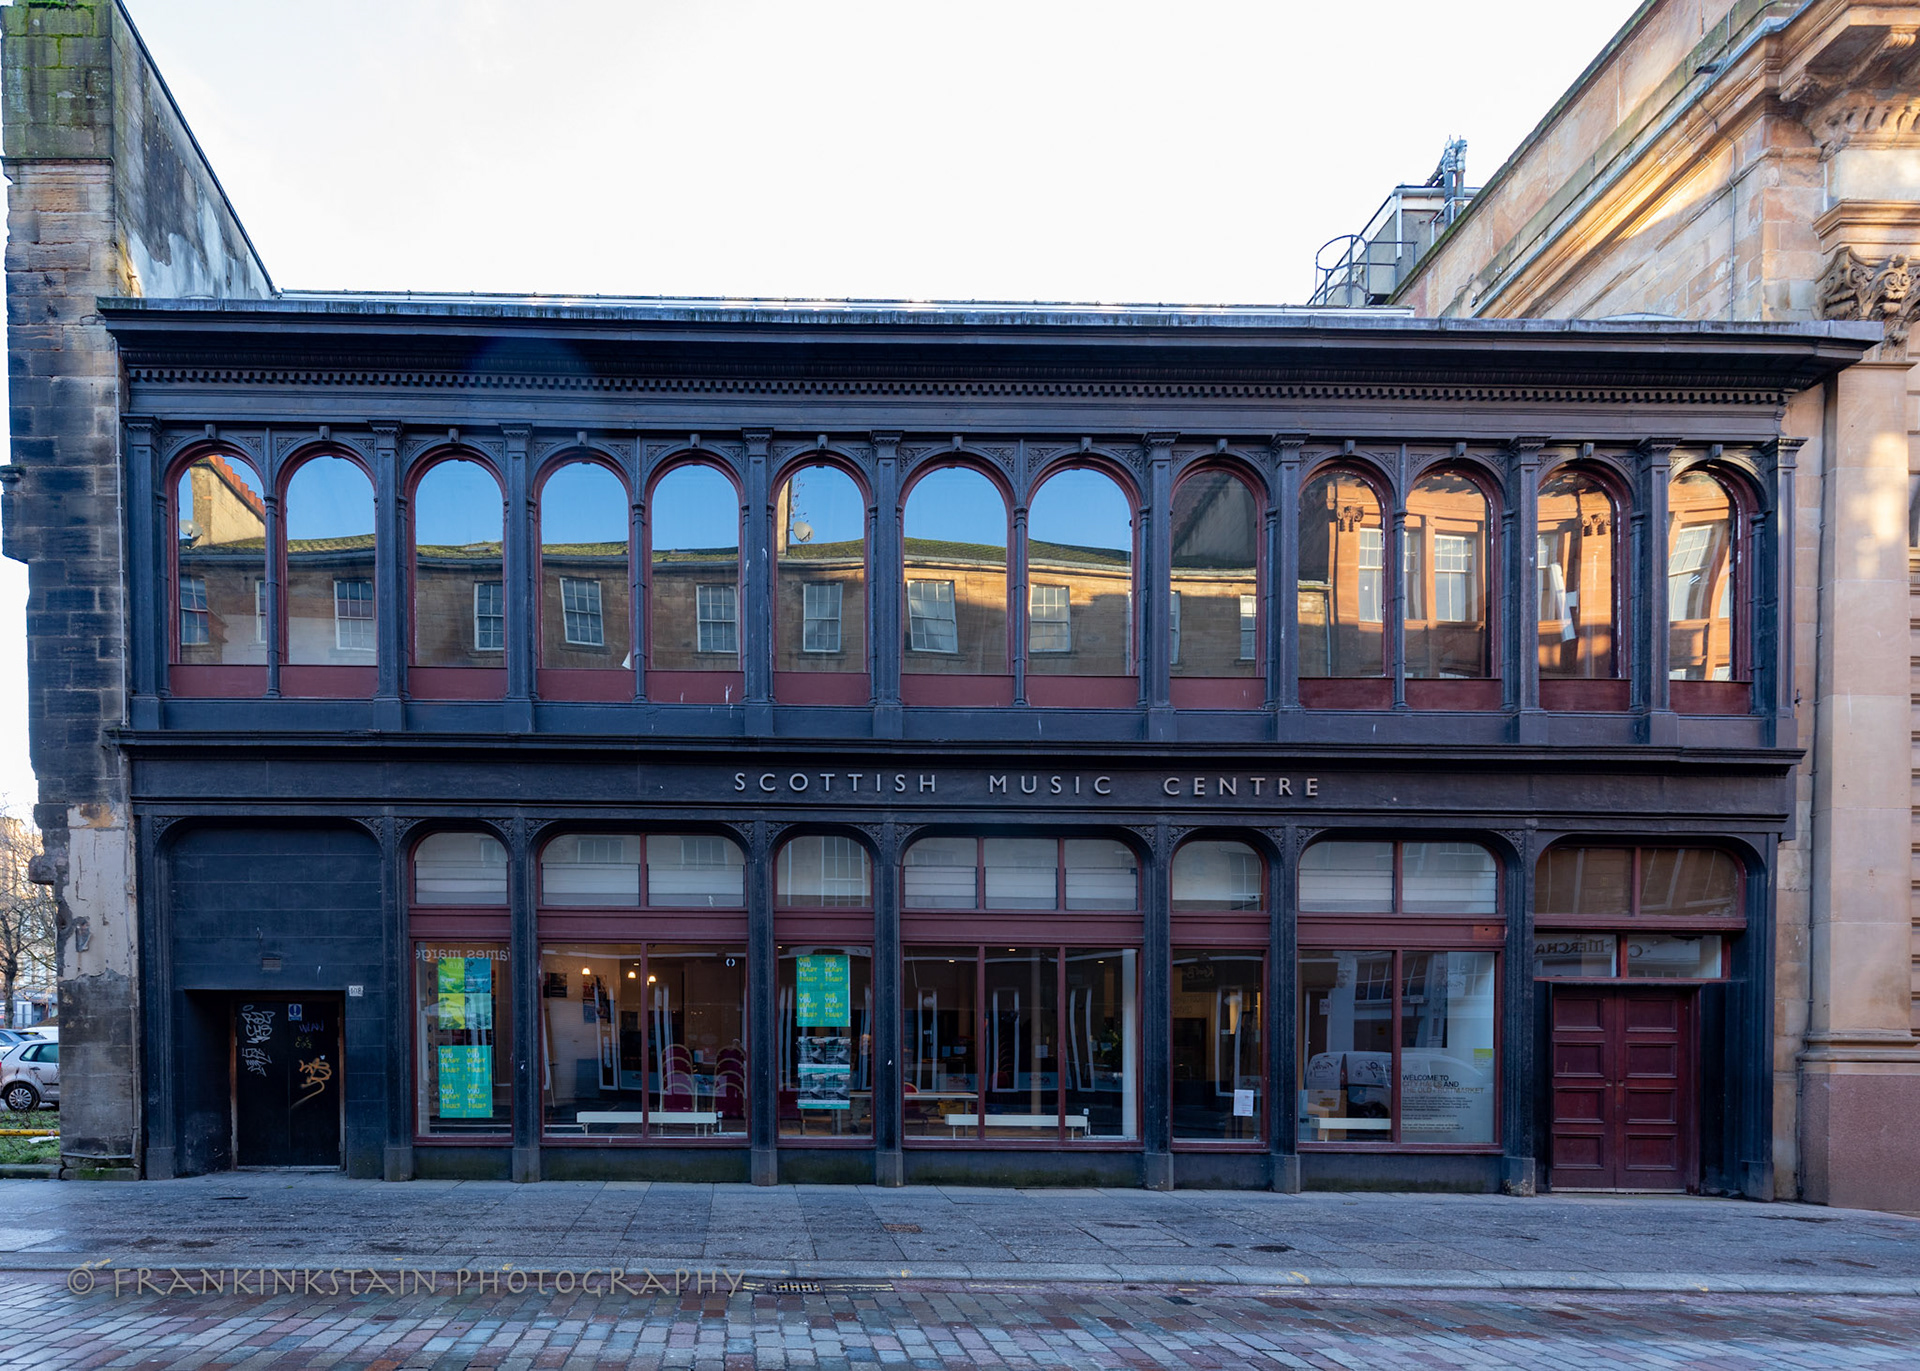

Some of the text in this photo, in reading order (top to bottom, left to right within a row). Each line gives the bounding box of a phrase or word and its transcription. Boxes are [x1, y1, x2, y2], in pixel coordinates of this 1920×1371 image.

[733, 771, 1320, 798] SCOTTISH MUSIC CENTRE
